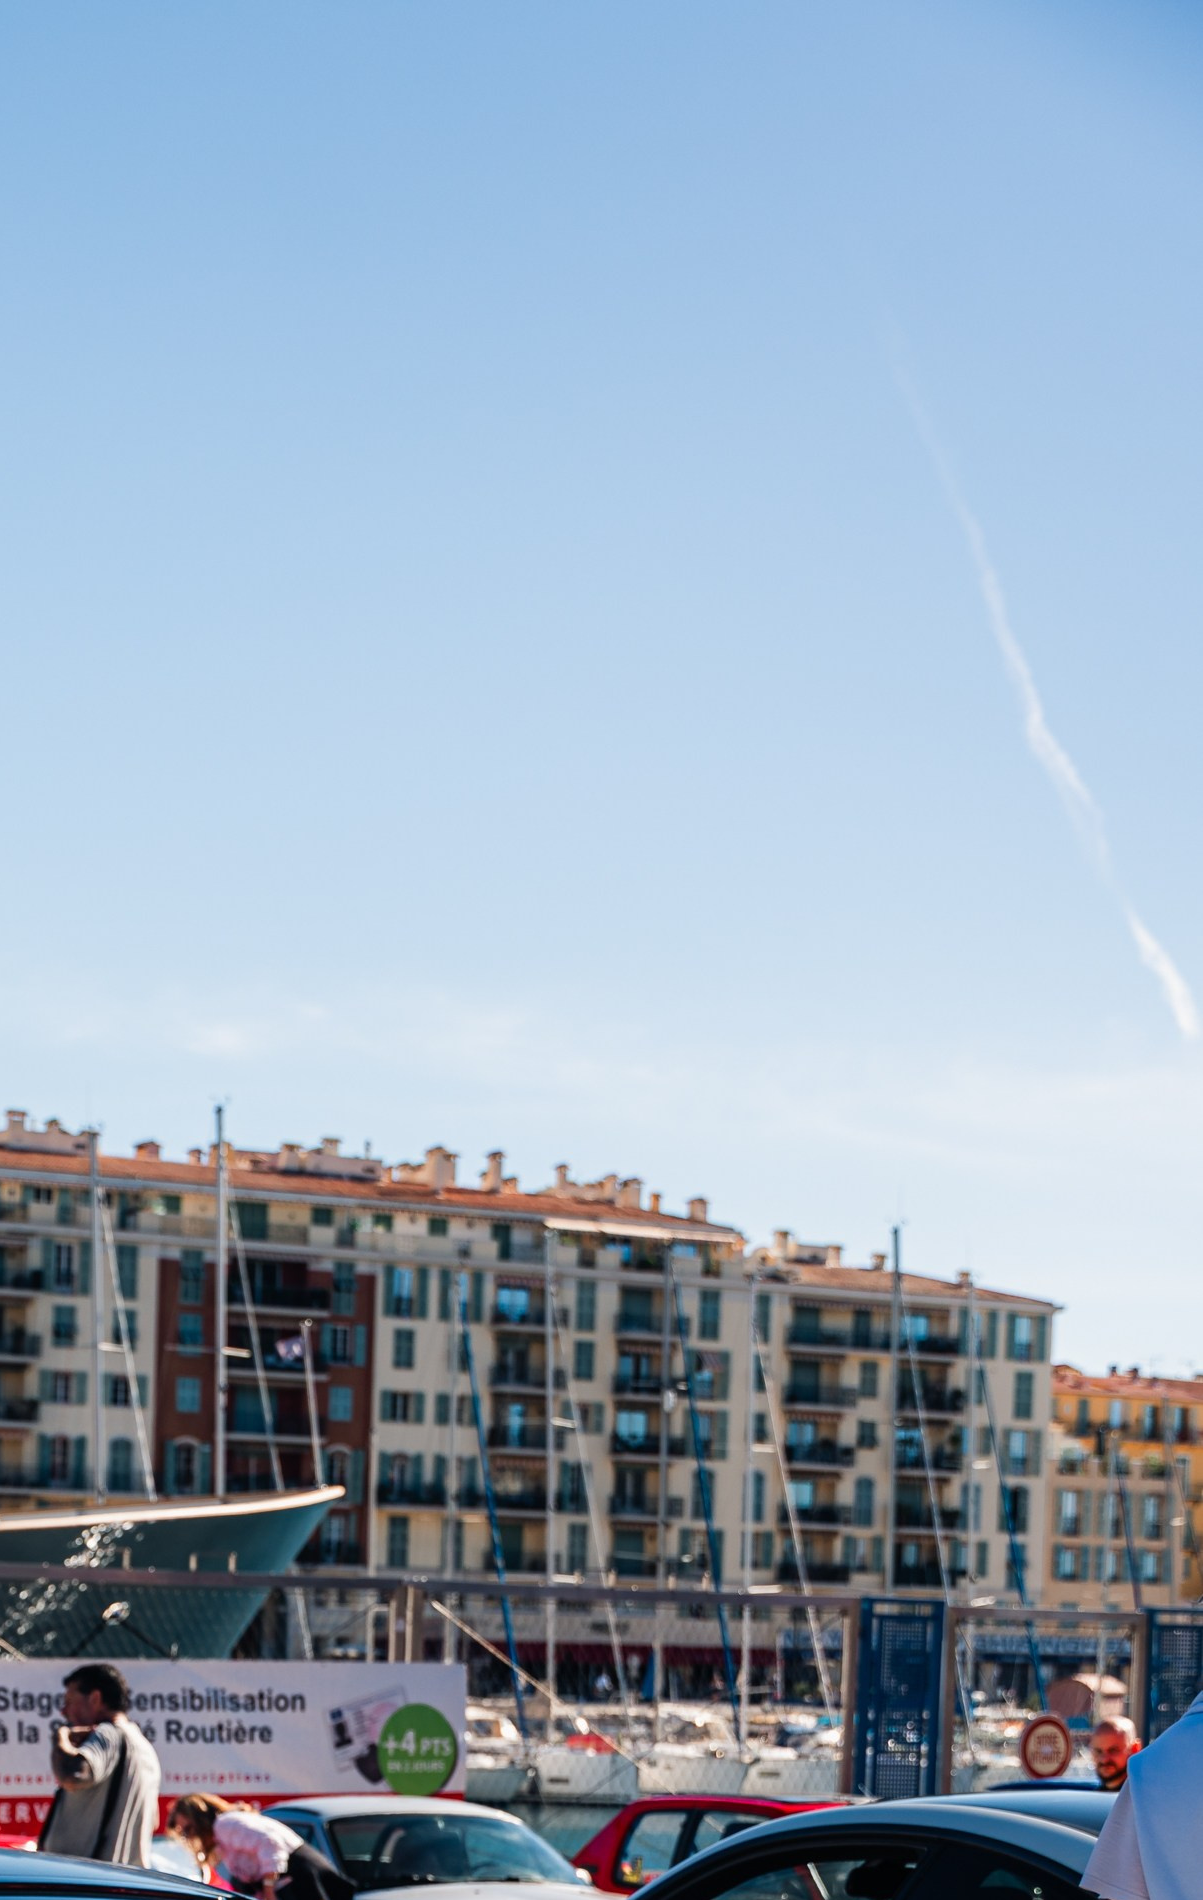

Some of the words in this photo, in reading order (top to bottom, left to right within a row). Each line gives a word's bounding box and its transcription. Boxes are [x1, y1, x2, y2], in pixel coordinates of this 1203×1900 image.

[17, 1720, 39, 1744] la
[165, 1720, 272, 1743] Routière
[383, 1728, 416, 1757] +4
[420, 1736, 452, 1757] PTS
